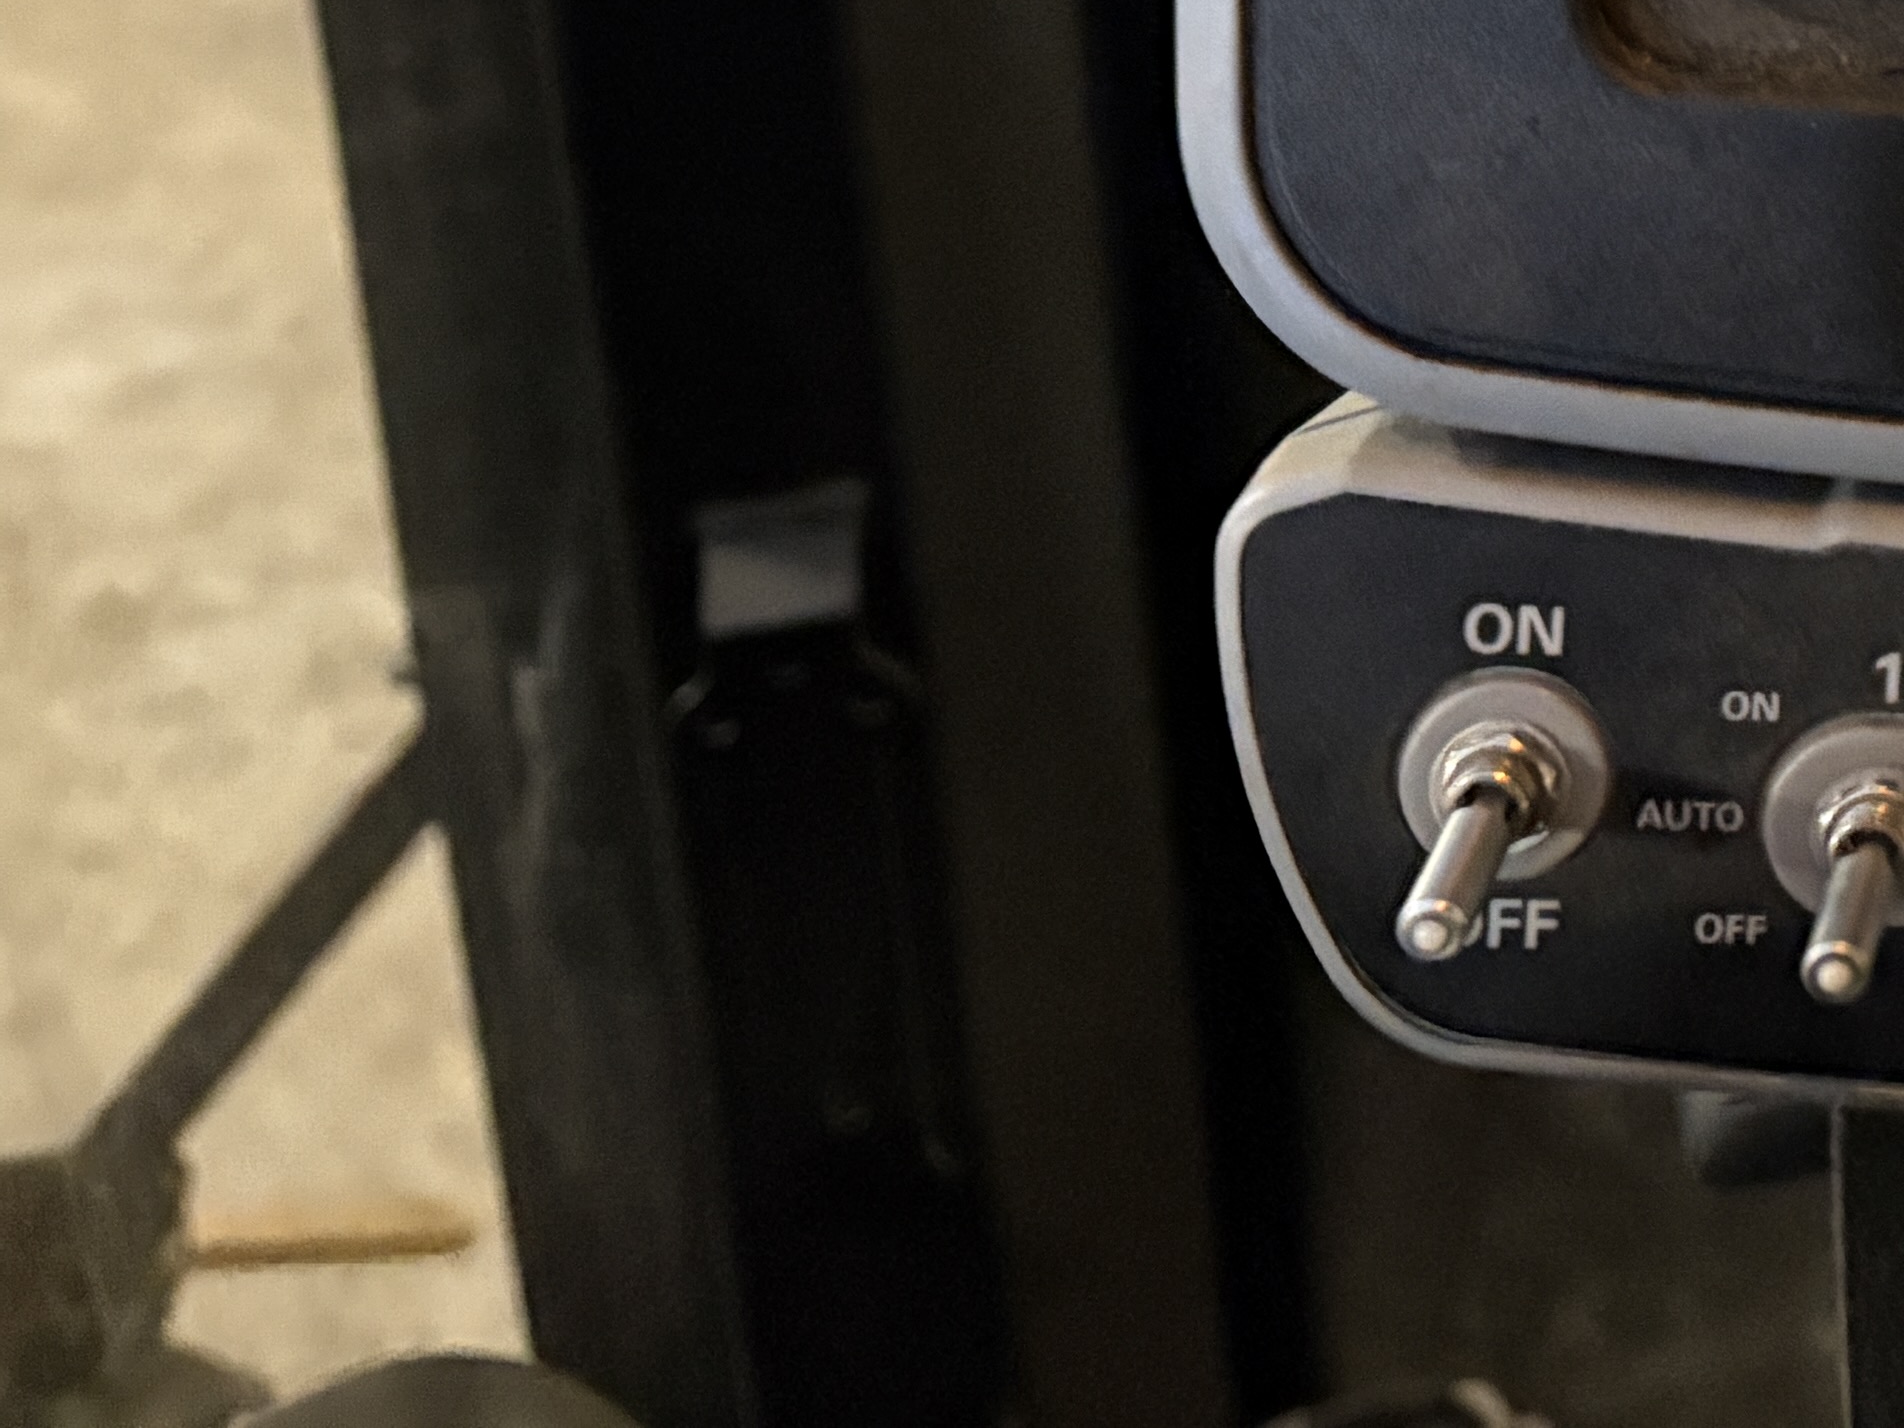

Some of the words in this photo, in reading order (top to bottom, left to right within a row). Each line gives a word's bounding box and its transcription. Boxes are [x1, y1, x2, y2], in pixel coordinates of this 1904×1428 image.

[1462, 601, 1566, 657] ON
[1874, 651, 1903, 705] 1
[1720, 689, 1781, 723] ON
[1635, 798, 1746, 834] AUTO
[1461, 897, 1562, 950] FF
[1693, 911, 1768, 945] OFF
